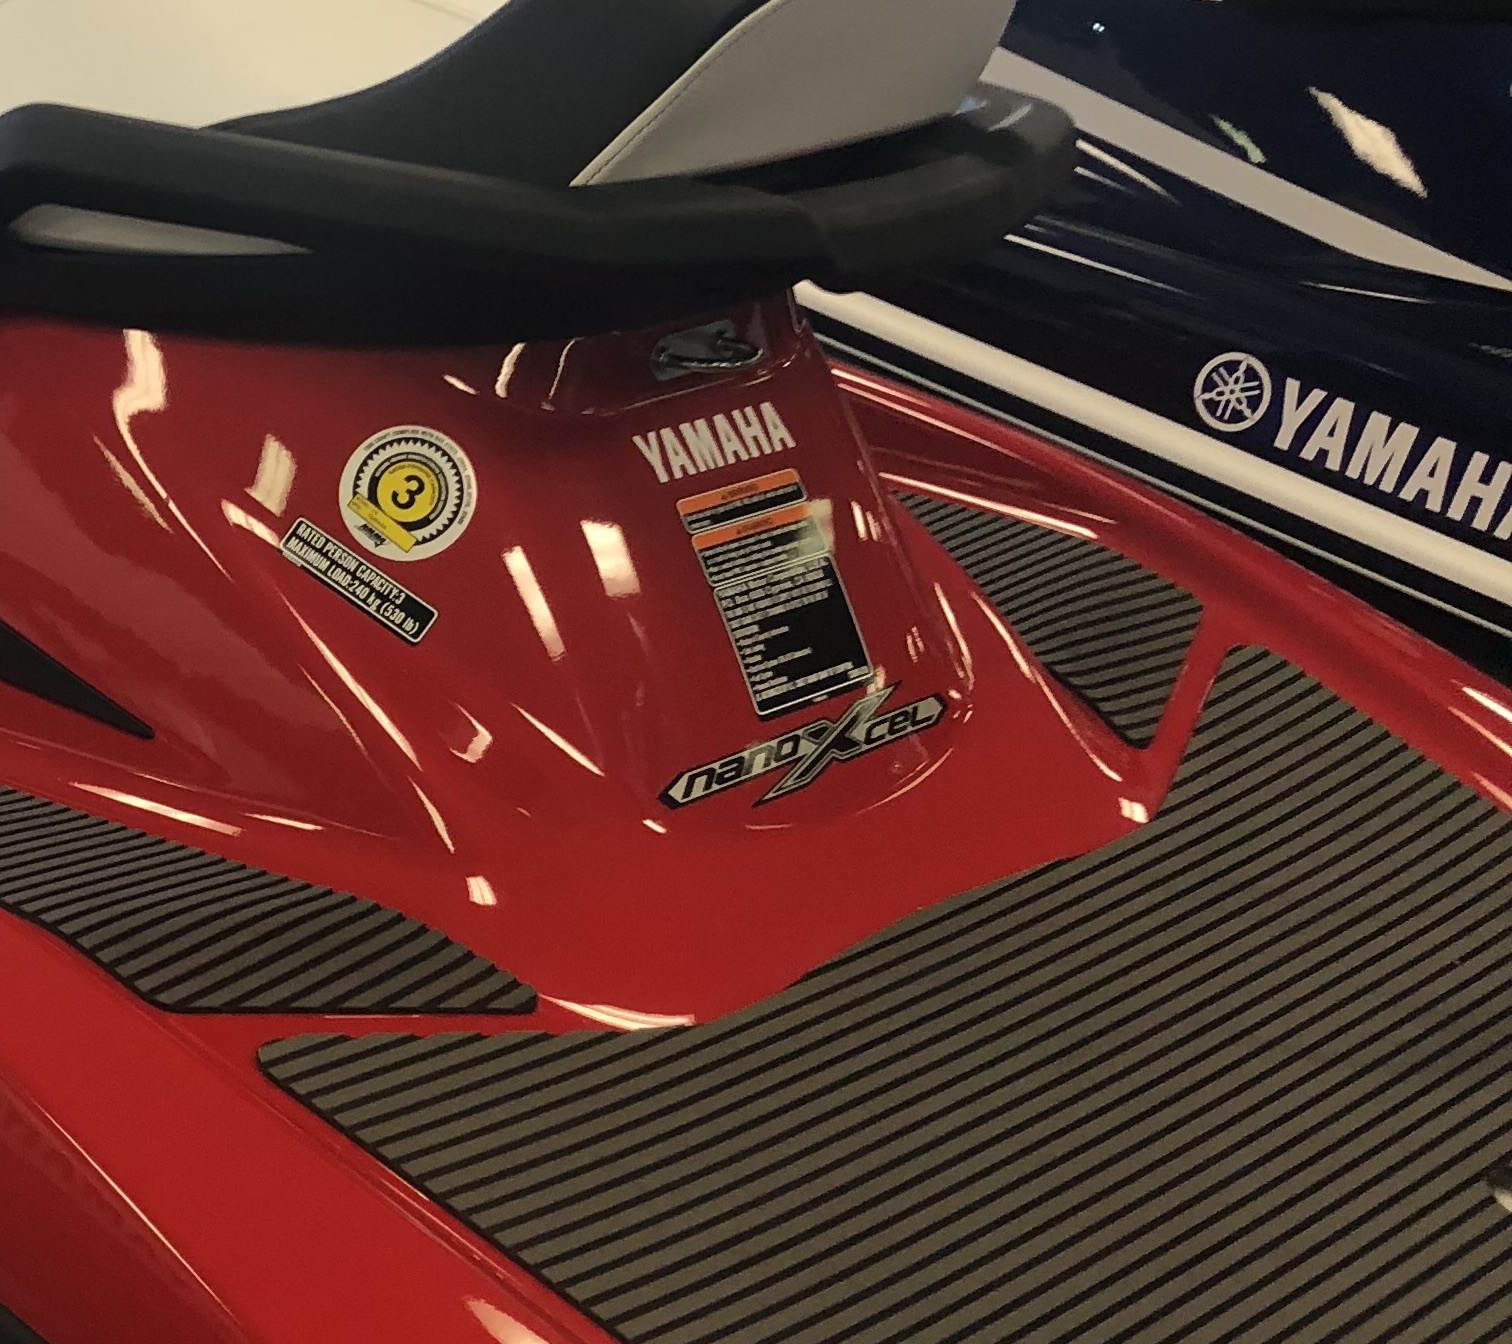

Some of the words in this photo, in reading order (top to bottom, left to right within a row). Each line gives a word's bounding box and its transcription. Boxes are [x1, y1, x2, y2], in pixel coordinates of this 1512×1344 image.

[632, 401, 797, 483] YAMAHA
[1274, 376, 1512, 541] YAMAH
[391, 474, 425, 510] 3
[287, 536, 331, 572] MAXIMUM
[327, 565, 370, 600] LOAD:240
[367, 592, 382, 613] kg
[380, 601, 406, 625] (530
[402, 613, 420, 635] lb)
[296, 523, 326, 549] RATED
[322, 542, 360, 573] PERSON
[356, 565, 406, 605] CAPACITY:3
